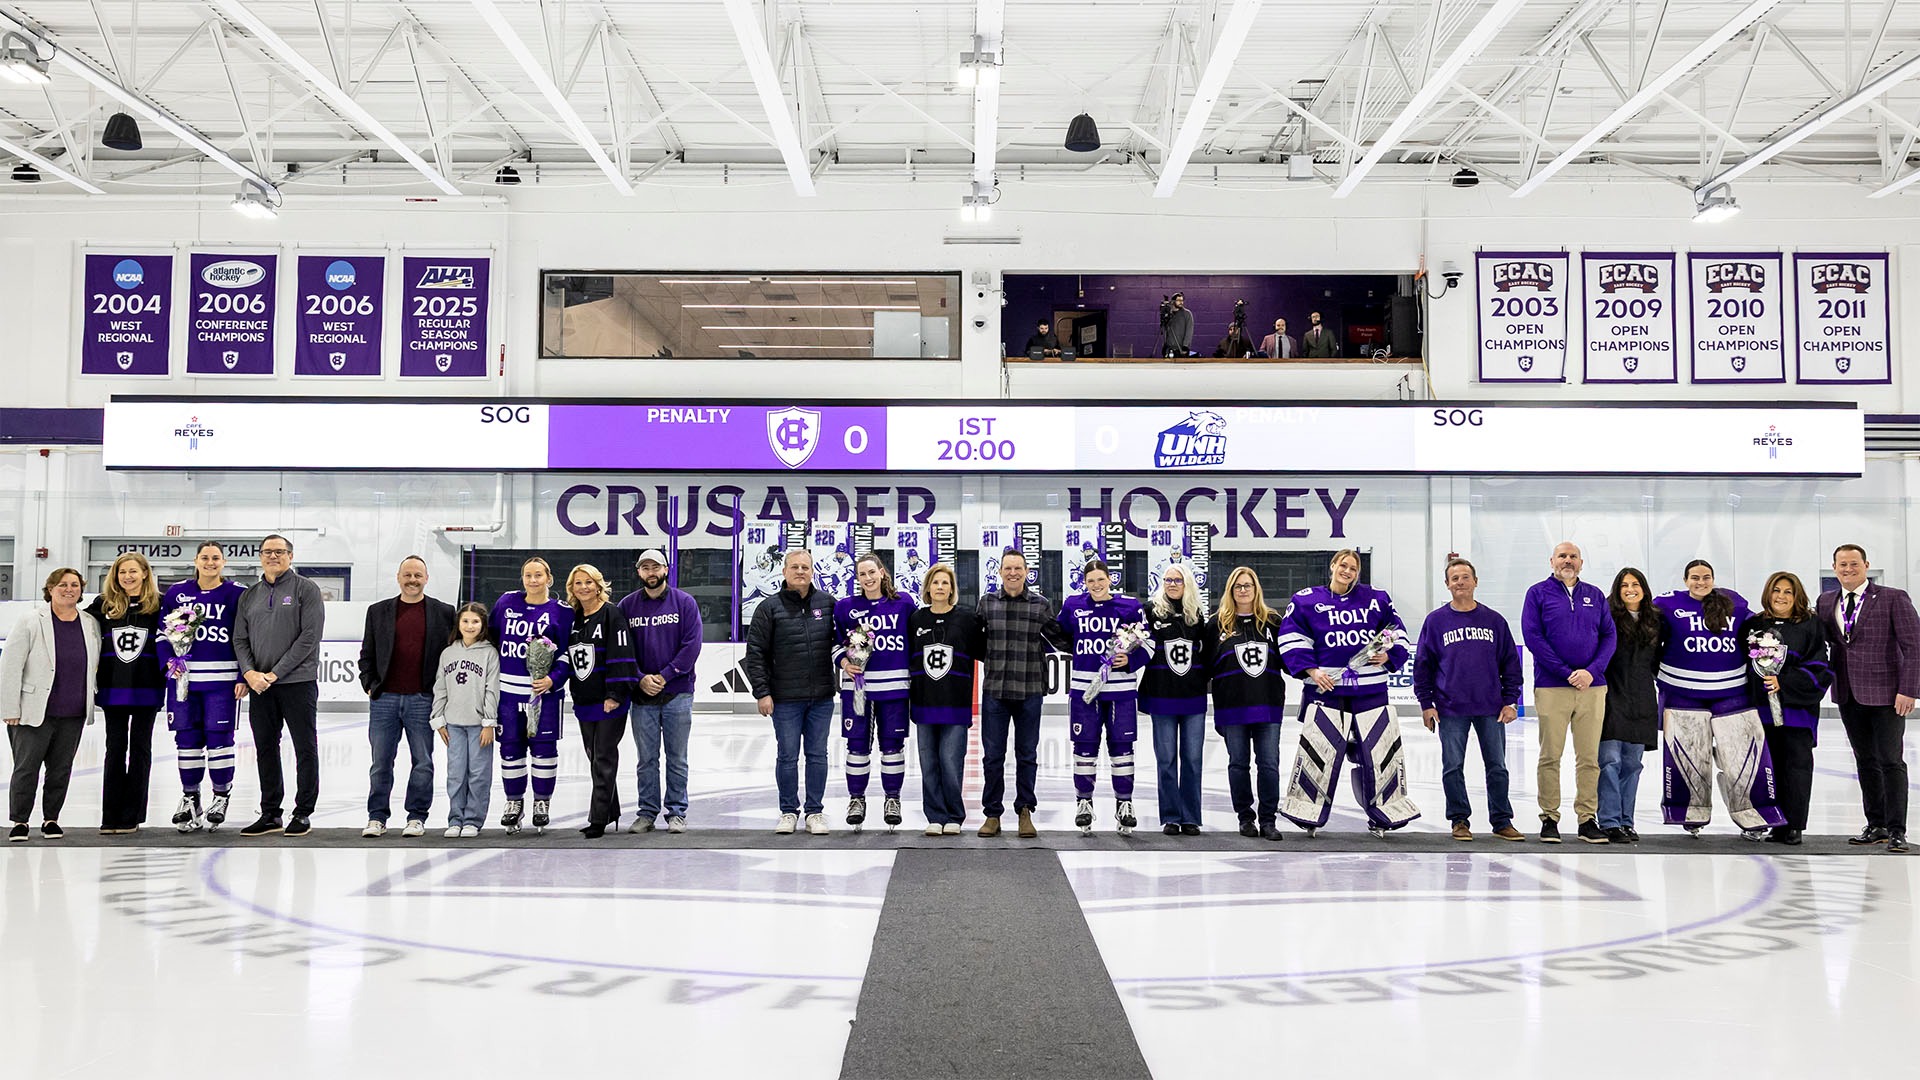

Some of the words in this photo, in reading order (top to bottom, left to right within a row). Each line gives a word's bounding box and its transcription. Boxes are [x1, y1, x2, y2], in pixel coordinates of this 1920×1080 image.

[115, 273, 143, 283] NCAA
[209, 272, 242, 283] hockey
[212, 266, 246, 276] atlantic
[328, 274, 356, 284] NCAA
[417, 267, 474, 287] AHA
[1495, 262, 1553, 283] ECAC
[1600, 264, 1659, 284] ECAC
[1707, 263, 1765, 283] ECAC
[1813, 264, 1871, 284] ECAC
[93, 293, 162, 315] 2004
[198, 292, 266, 315] 2006
[305, 294, 374, 316] 2006
[412, 296, 478, 318] 2025
[1491, 297, 1559, 317] 2003
[1595, 298, 1663, 319] 2009
[1707, 298, 1765, 318] 2010
[1818, 299, 1867, 319] 2011
[110, 321, 143, 331] WEST
[195, 319, 269, 331] CONFERENCE
[323, 321, 356, 332] WEST
[418, 319, 471, 329] REGULAR
[1506, 323, 1545, 335] OPEN
[1611, 325, 1650, 336] OPEN
[1718, 325, 1756, 336] OPEN
[1823, 326, 1861, 337] OPEN
[97, 333, 154, 344] REGIONAL
[197, 332, 265, 343] CHAMPIONS
[309, 333, 368, 345] REGIONAL
[421, 329, 468, 340] SEASON
[410, 340, 478, 351] CHAMPIONS
[1485, 339, 1566, 350] CHAMPIONS
[1590, 340, 1670, 352] CHAMPIONS
[1698, 340, 1779, 351] CHAMPIONS
[1803, 341, 1883, 352] CHAMPIONS
[480, 406, 531, 424] SOG
[647, 407, 731, 424] PENALTY
[1236, 409, 1320, 424] PENALTY
[1433, 409, 1484, 427] SOG
[174, 429, 214, 437] REYES
[957, 417, 997, 436] 1ST
[843, 424, 869, 455] 0
[1095, 424, 1119, 456] 0
[1160, 432, 1227, 456] UNH
[1753, 438, 1793, 446] REYES
[937, 439, 1016, 462] 20:00
[1158, 454, 1225, 467] WILDCATS
[556, 484, 938, 537] CRUSADER
[1067, 486, 1361, 539] HOCKEY
[166, 525, 181, 537] EXIT
[747, 527, 765, 545] #31
[787, 522, 805, 549] UNG
[815, 529, 835, 546] #26
[898, 531, 918, 547] #23
[982, 530, 998, 547] #11
[1066, 530, 1080, 546] #8
[1151, 530, 1171, 546] #30
[854, 524, 872, 560] ONNTAG
[938, 525, 955, 572] ANTELON
[1023, 525, 1039, 568] MOREAU
[1105, 523, 1123, 570] LEWIS
[1369, 598, 1381, 612] A
[537, 612, 550, 625] A
[628, 617, 649, 629] HOLY
[652, 613, 680, 627] CROSS
[1078, 616, 1120, 634] HOLY
[1327, 608, 1369, 626] HOLY
[1690, 615, 1736, 631] HY
[195, 625, 230, 643] OSS
[504, 618, 550, 637] HOLY
[592, 623, 603, 639] A
[617, 630, 628, 646] 11
[874, 635, 904, 651] OSS
[1324, 629, 1377, 648] CROSS
[1443, 626, 1465, 647] HOLY
[1466, 626, 1495, 643] CROSS
[1684, 636, 1736, 653] CROSS
[500, 640, 529, 659] CRO
[443, 660, 460, 676] HOLY
[460, 659, 484, 678] CROSS
[1290, 756, 1303, 794] TRUE
[1765, 767, 1775, 800] BAUER
[1126, 930, 1800, 1011] CRUSADERS
